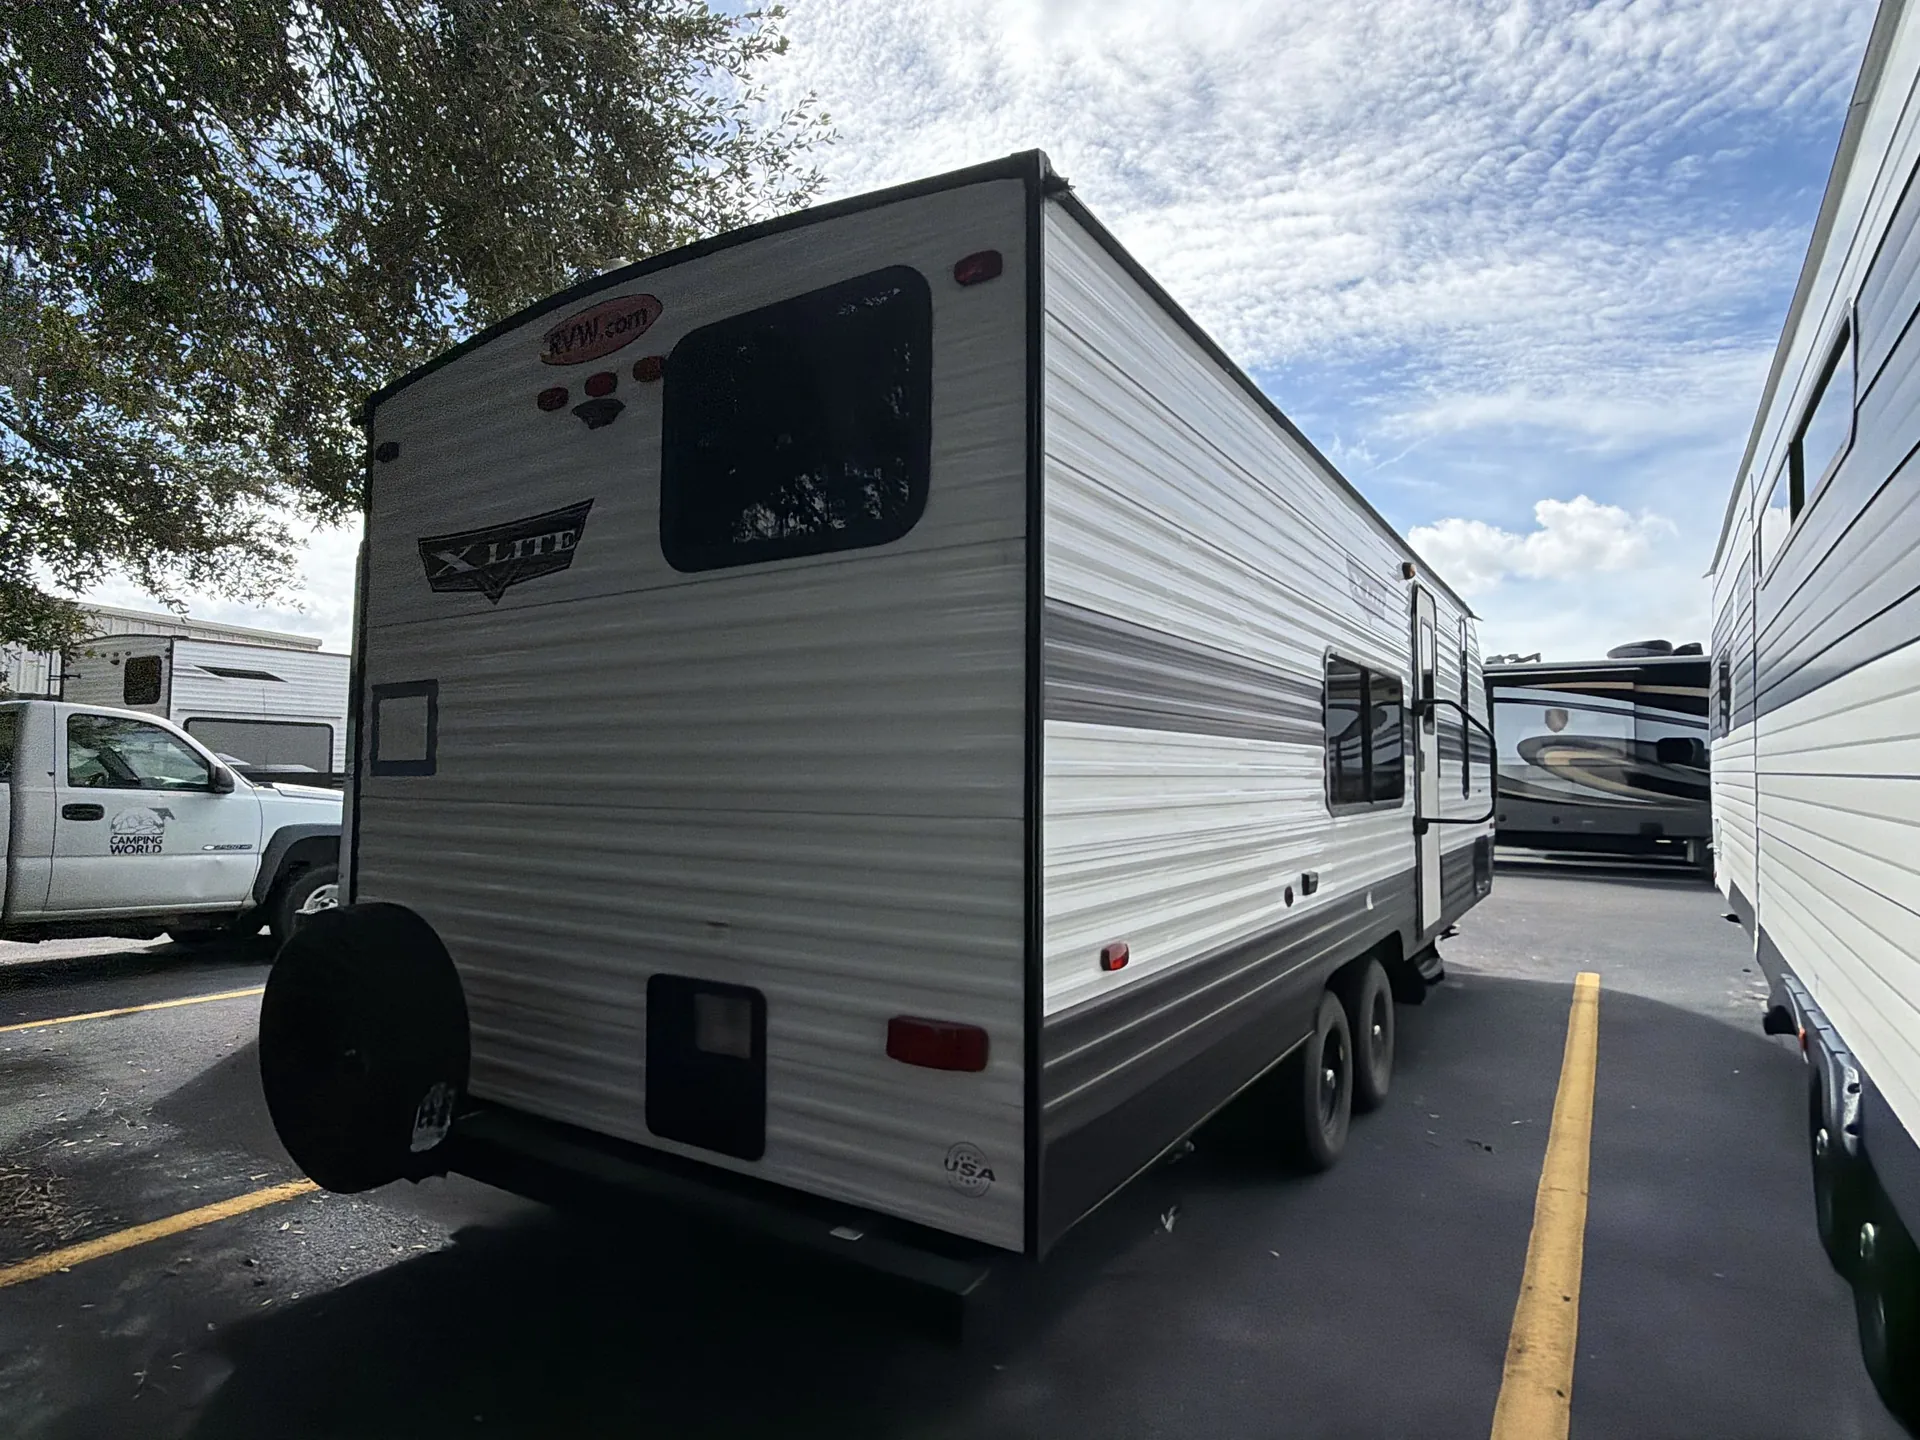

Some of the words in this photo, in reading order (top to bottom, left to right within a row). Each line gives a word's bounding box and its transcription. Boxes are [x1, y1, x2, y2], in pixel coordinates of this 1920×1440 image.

[430, 544, 480, 576] X
[110, 835, 163, 845] CAMPING
[110, 844, 163, 854] WORLD
[944, 1158, 996, 1182] USA
